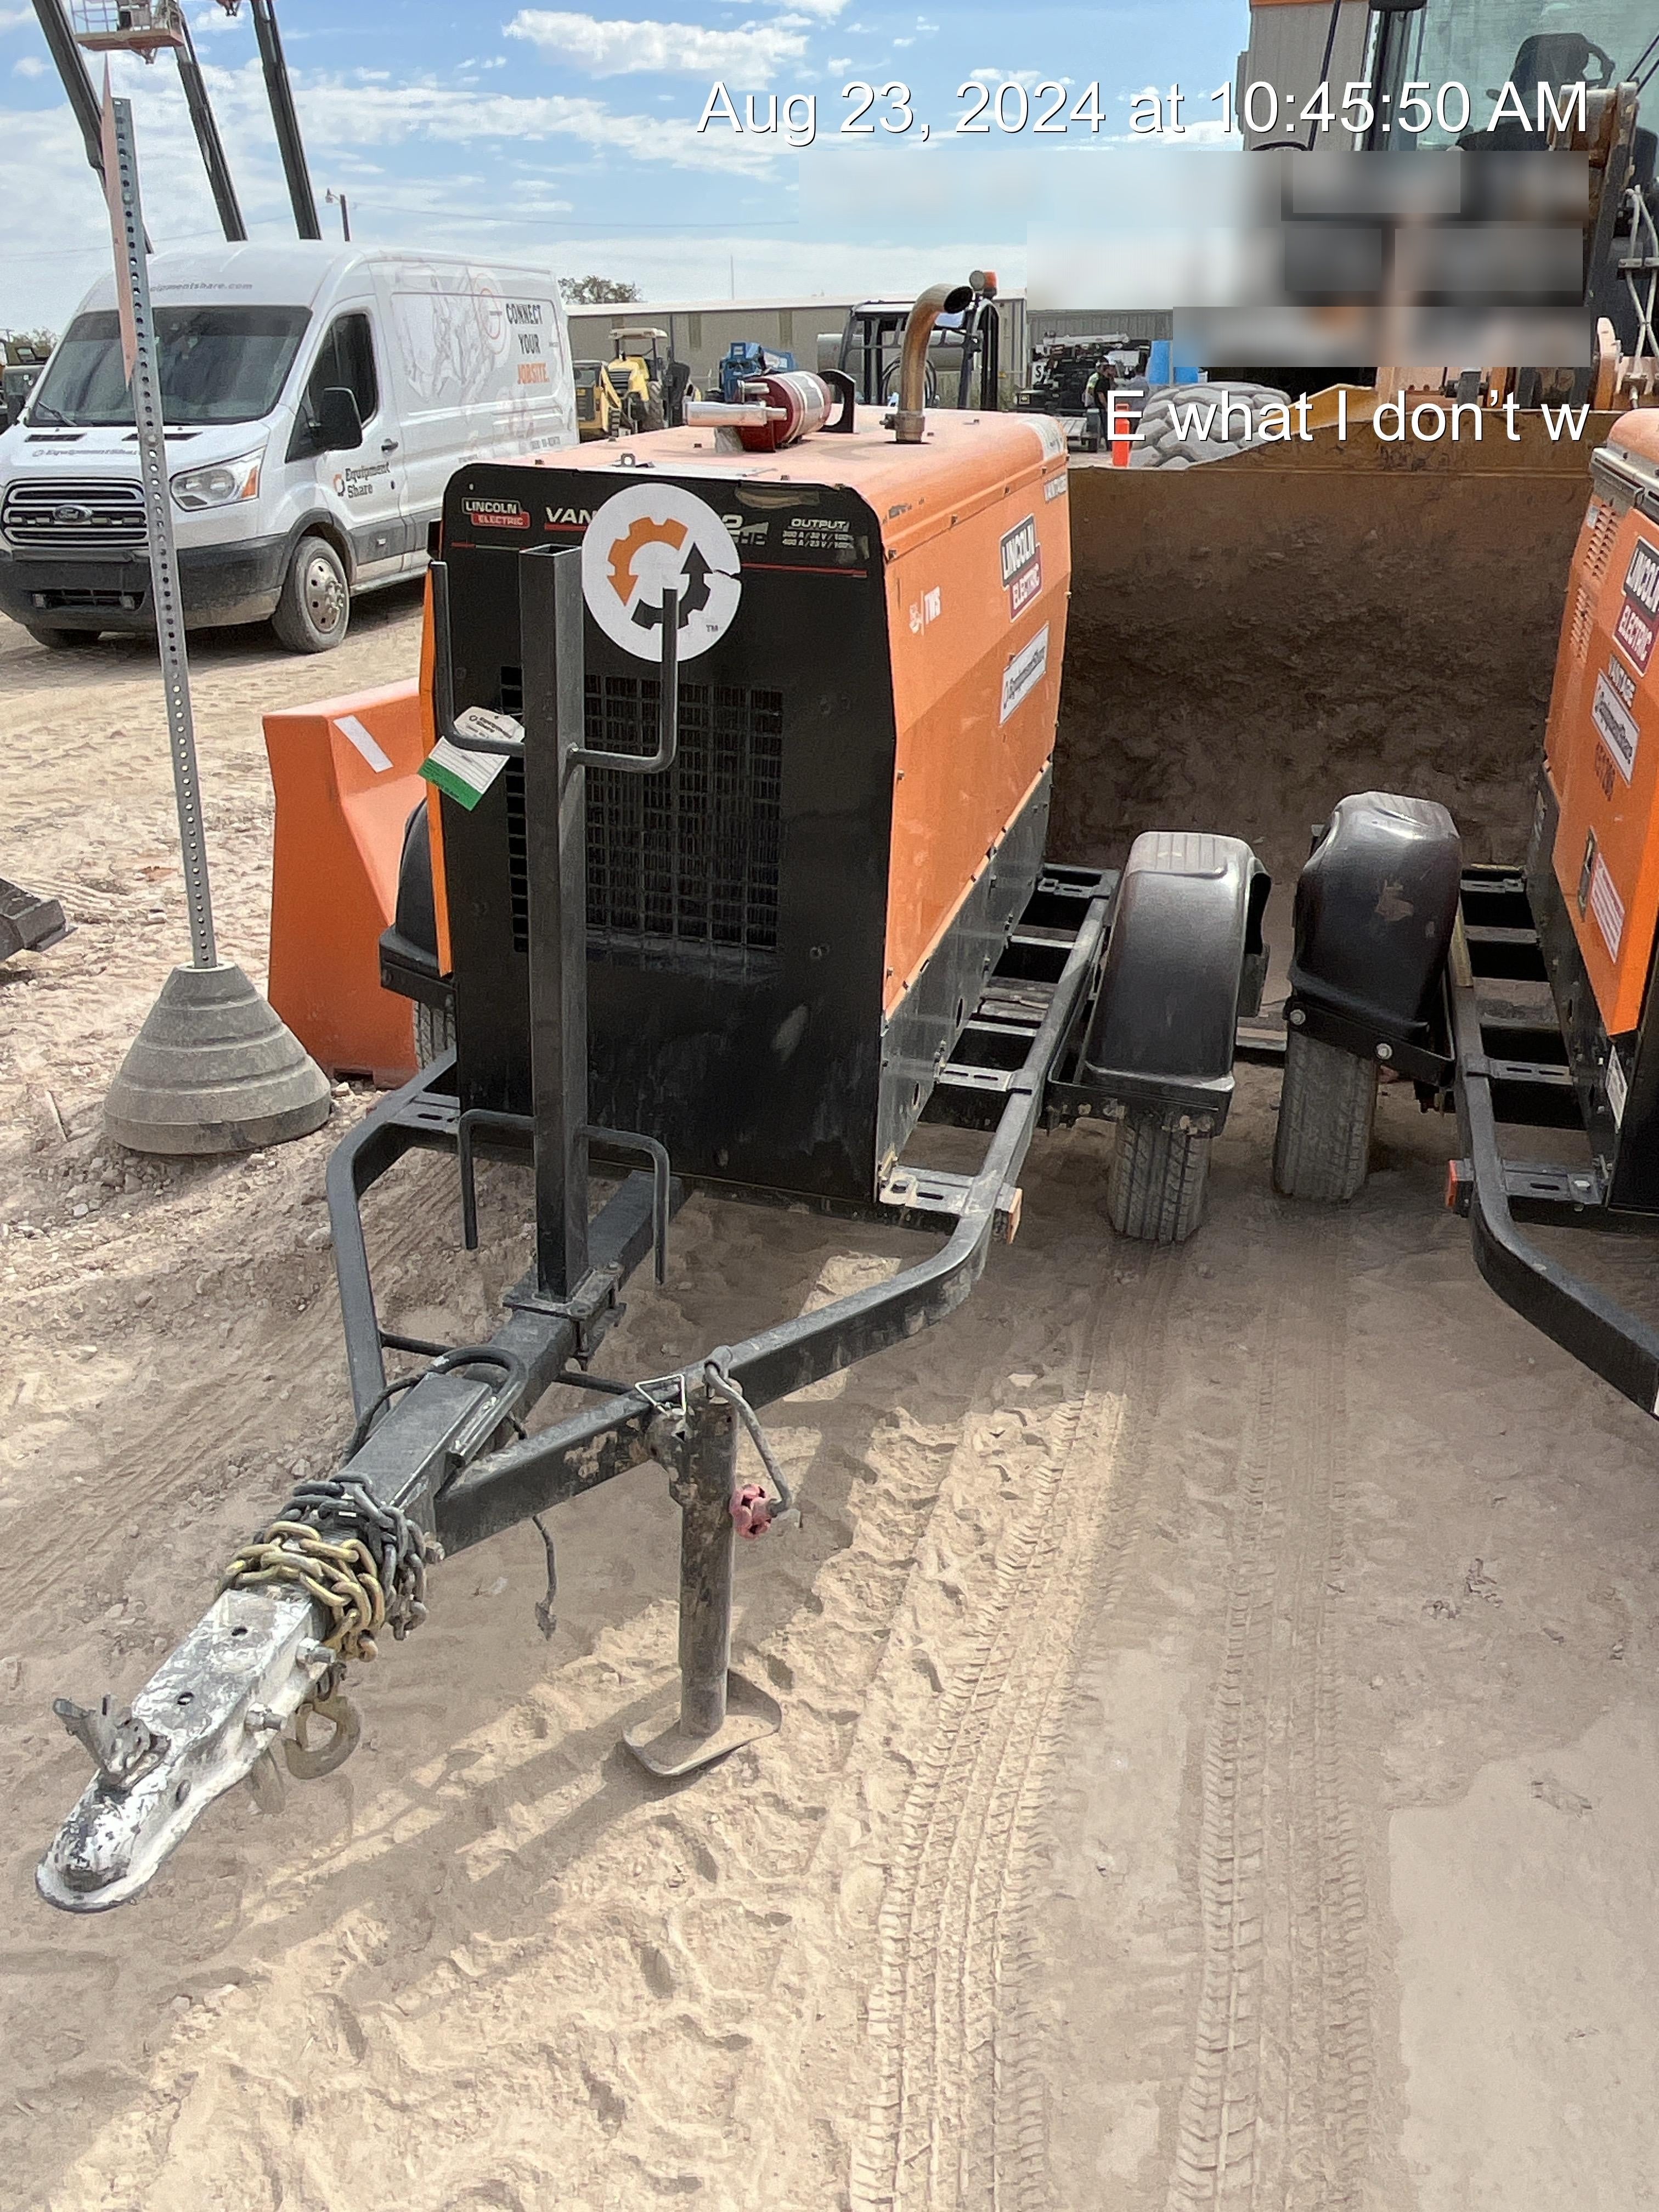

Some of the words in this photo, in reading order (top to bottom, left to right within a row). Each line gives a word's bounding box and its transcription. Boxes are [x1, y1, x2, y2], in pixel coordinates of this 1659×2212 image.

[506, 303, 543, 325] CONNECT
[518, 334, 541, 354] YOUR
[345, 461, 391, 483] Equipment
[347, 483, 373, 499] Share
[466, 501, 517, 515] LINCOLN
[546, 506, 595, 524] VAN
[477, 515, 524, 526] ELECTRIC
[791, 518, 847, 530] OUTPUT
[1002, 523, 1035, 580] LINCOLN
